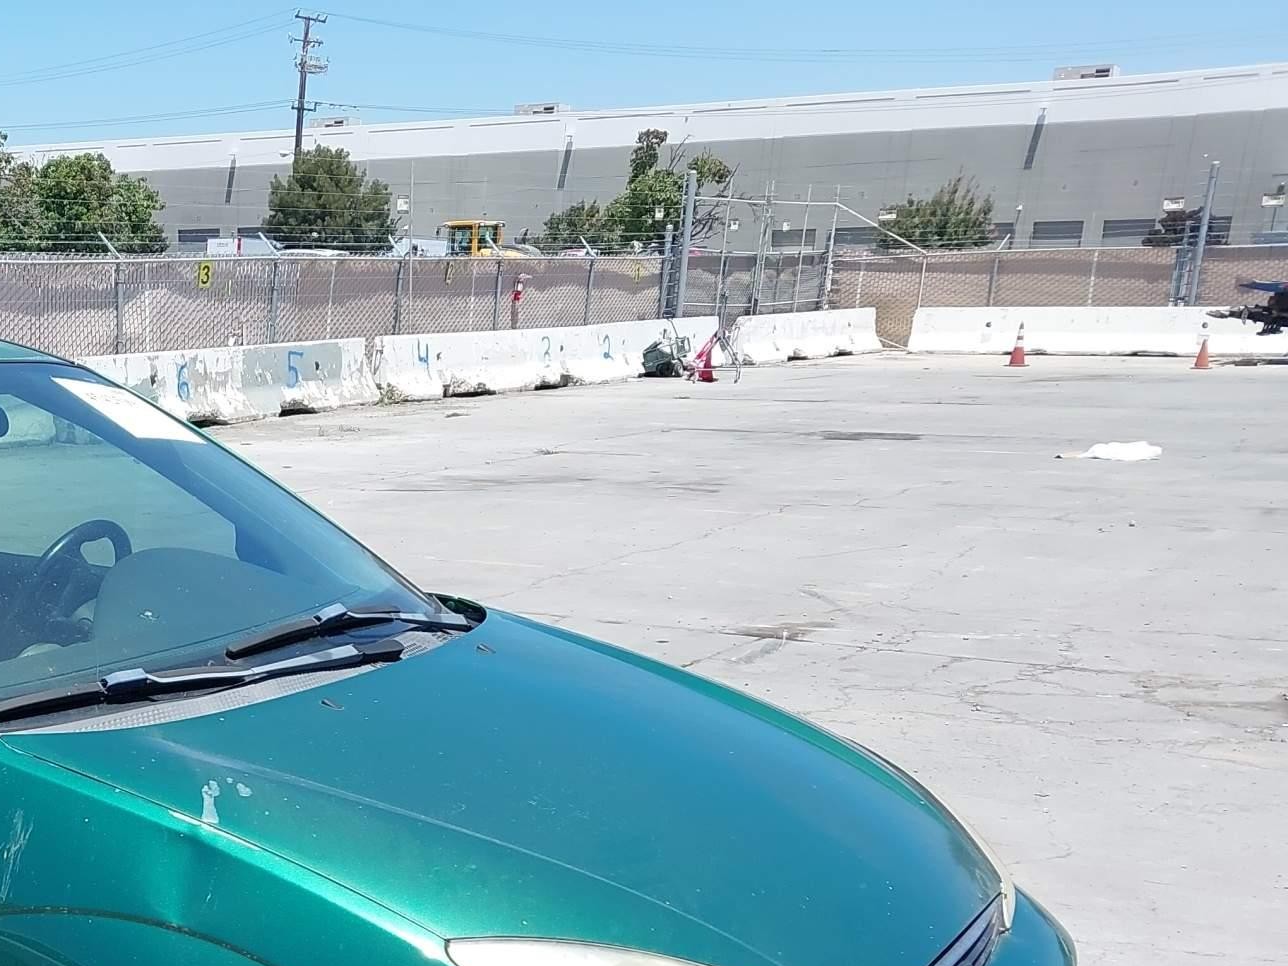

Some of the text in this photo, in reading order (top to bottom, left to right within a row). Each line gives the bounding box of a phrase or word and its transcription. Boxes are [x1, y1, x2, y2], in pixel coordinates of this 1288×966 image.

[201, 265, 210, 284] 3
[602, 334, 614, 361] 2
[177, 361, 191, 401] 6
[286, 350, 304, 389] 5
